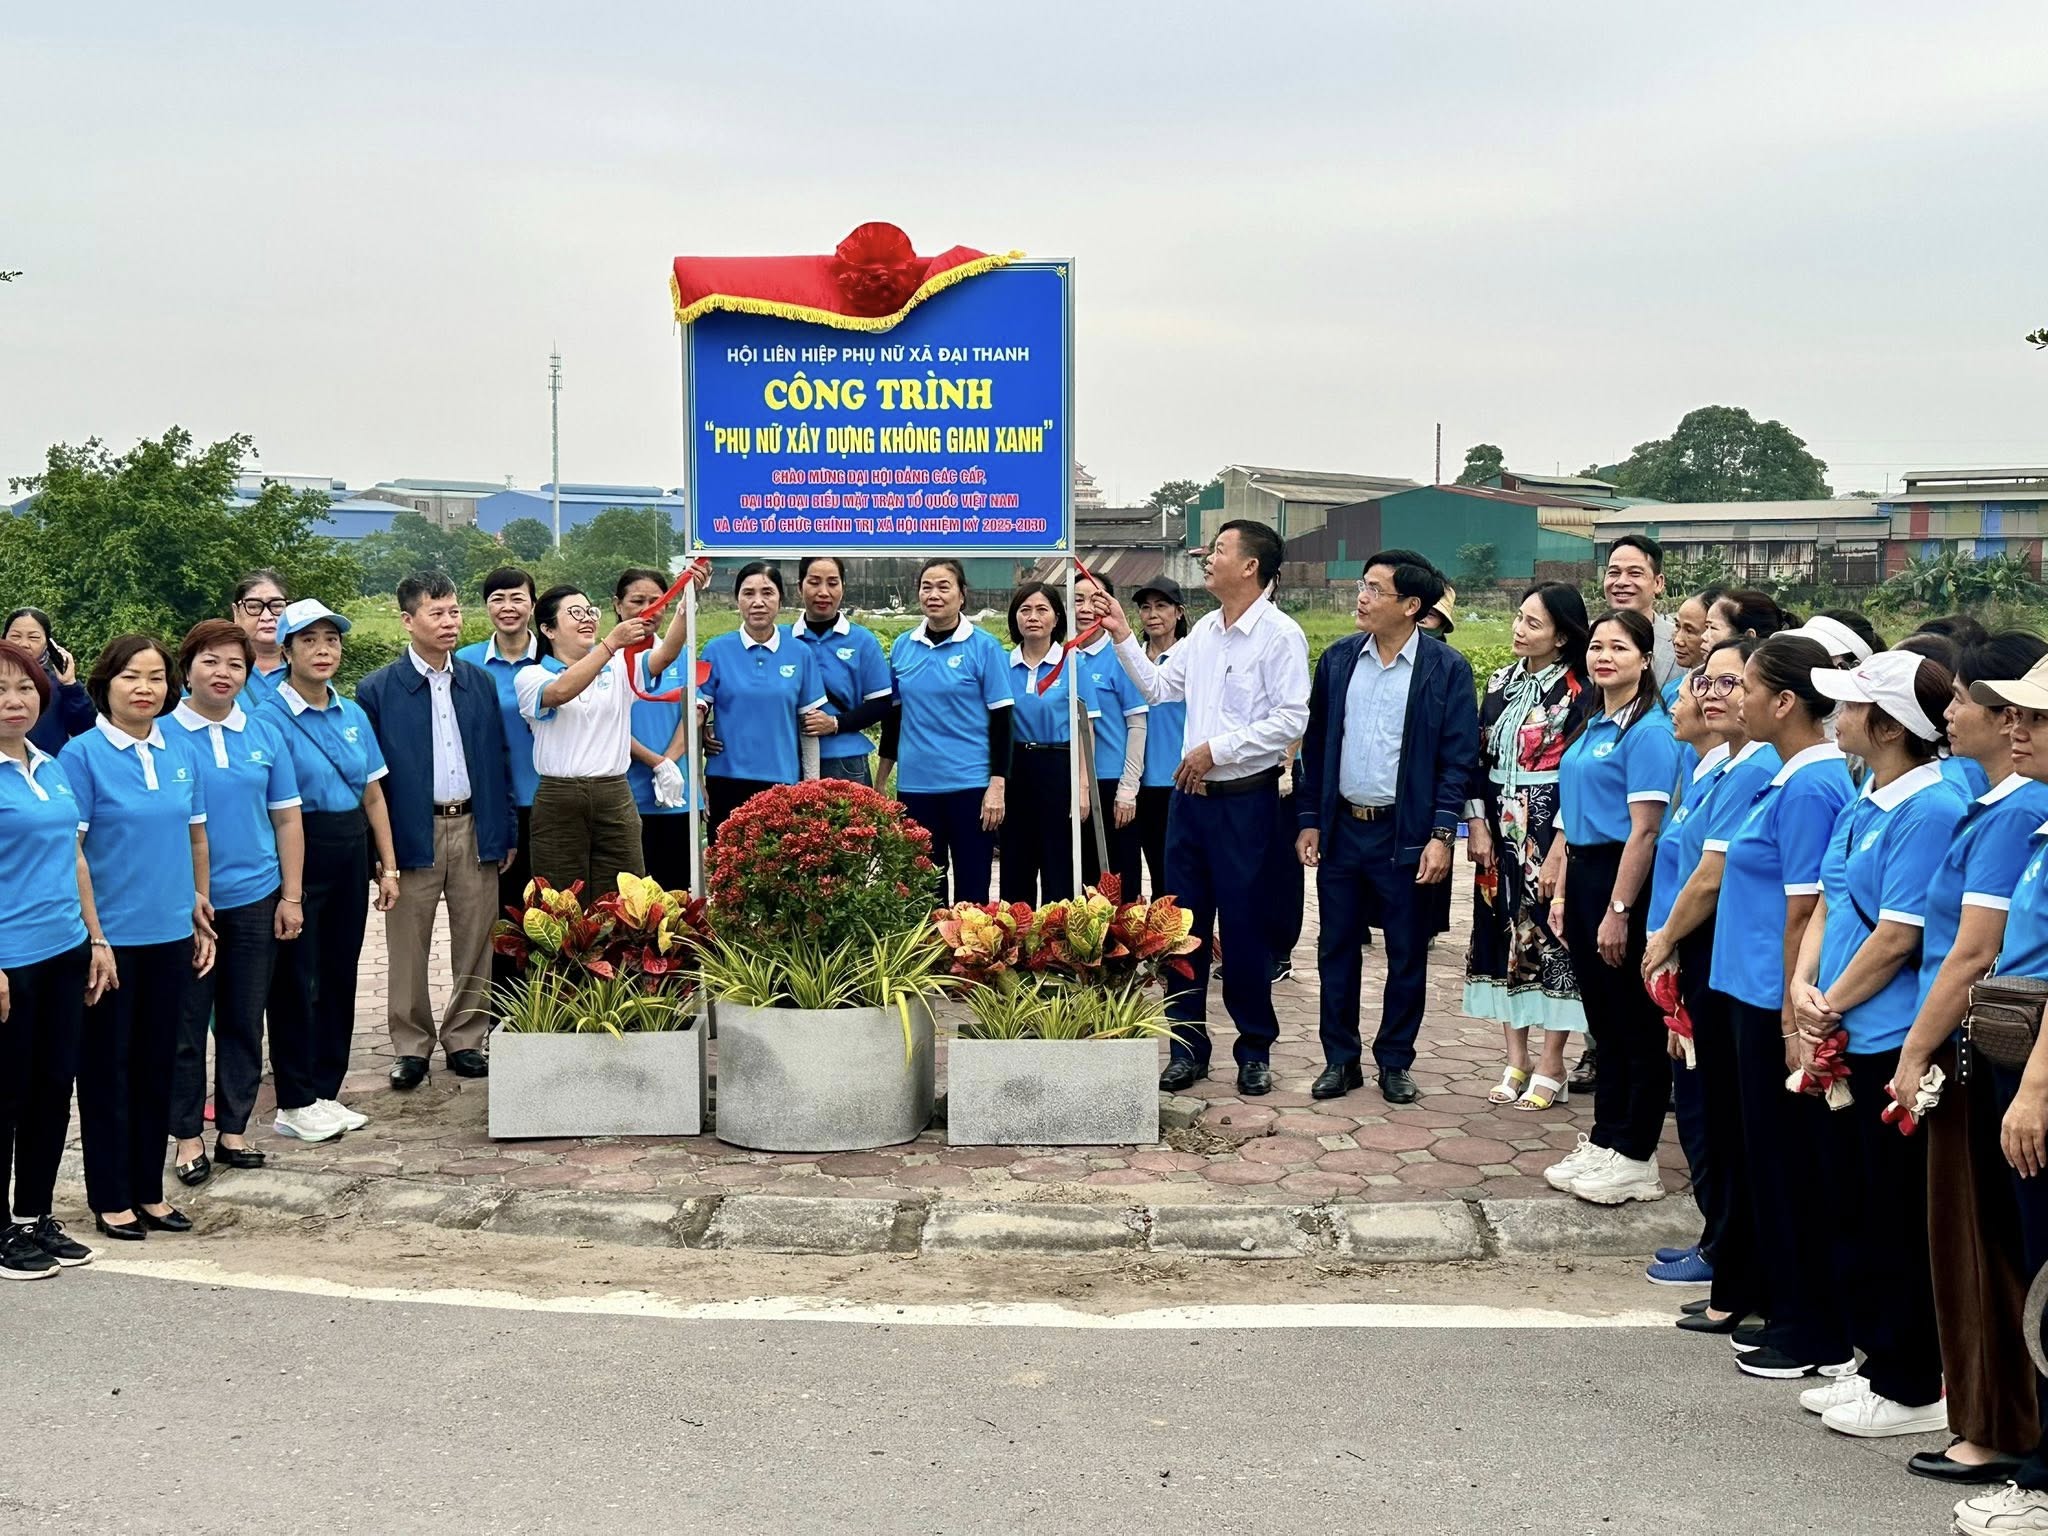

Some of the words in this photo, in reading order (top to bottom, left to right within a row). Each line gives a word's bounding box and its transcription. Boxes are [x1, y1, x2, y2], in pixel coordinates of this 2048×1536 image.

[727, 345, 757, 366] HỘI
[763, 345, 796, 362] LIÊN
[801, 345, 837, 366] HIỆP
[842, 348, 875, 366] PHỤ
[881, 345, 904, 362] NỮ
[909, 345, 933, 362] XÃ
[938, 348, 967, 365] ĐẠI
[972, 347, 1029, 362] THANH
[764, 370, 867, 410] CÔNG
[876, 370, 993, 410] TRÌNH
[756, 422, 782, 454] NỮ
[786, 422, 821, 454] XÂY
[826, 425, 875, 459] DỰNG
[880, 421, 941, 454] KHÔNG
[946, 427, 989, 454] GIAN
[772, 467, 806, 484] CHÀO
[808, 467, 845, 484] MỪNG
[847, 469, 869, 486] ĐẠI
[871, 467, 892, 486] HỘI
[895, 465, 929, 484] ĐẢNG
[931, 467, 957, 484] CÁC
[740, 494, 761, 511] ĐẠI
[764, 491, 785, 511] HỘI
[787, 494, 808, 511] ĐẠI
[843, 491, 869, 511] MẶT
[872, 491, 904, 510] TRẬN
[925, 489, 958, 509] QUỐC
[961, 491, 987, 510] VIỆT
[990, 493, 1019, 508] NAM
[713, 515, 730, 532] VÀ
[733, 515, 758, 532] CÁC
[778, 515, 812, 532] CHỨC
[814, 515, 851, 532] CHÍNH
[854, 518, 874, 535] TRỊ
[877, 516, 894, 532] XÃ
[896, 515, 918, 535] HỘI
[920, 515, 960, 535] NHIỆM
[982, 518, 1046, 532] 2025-2030
